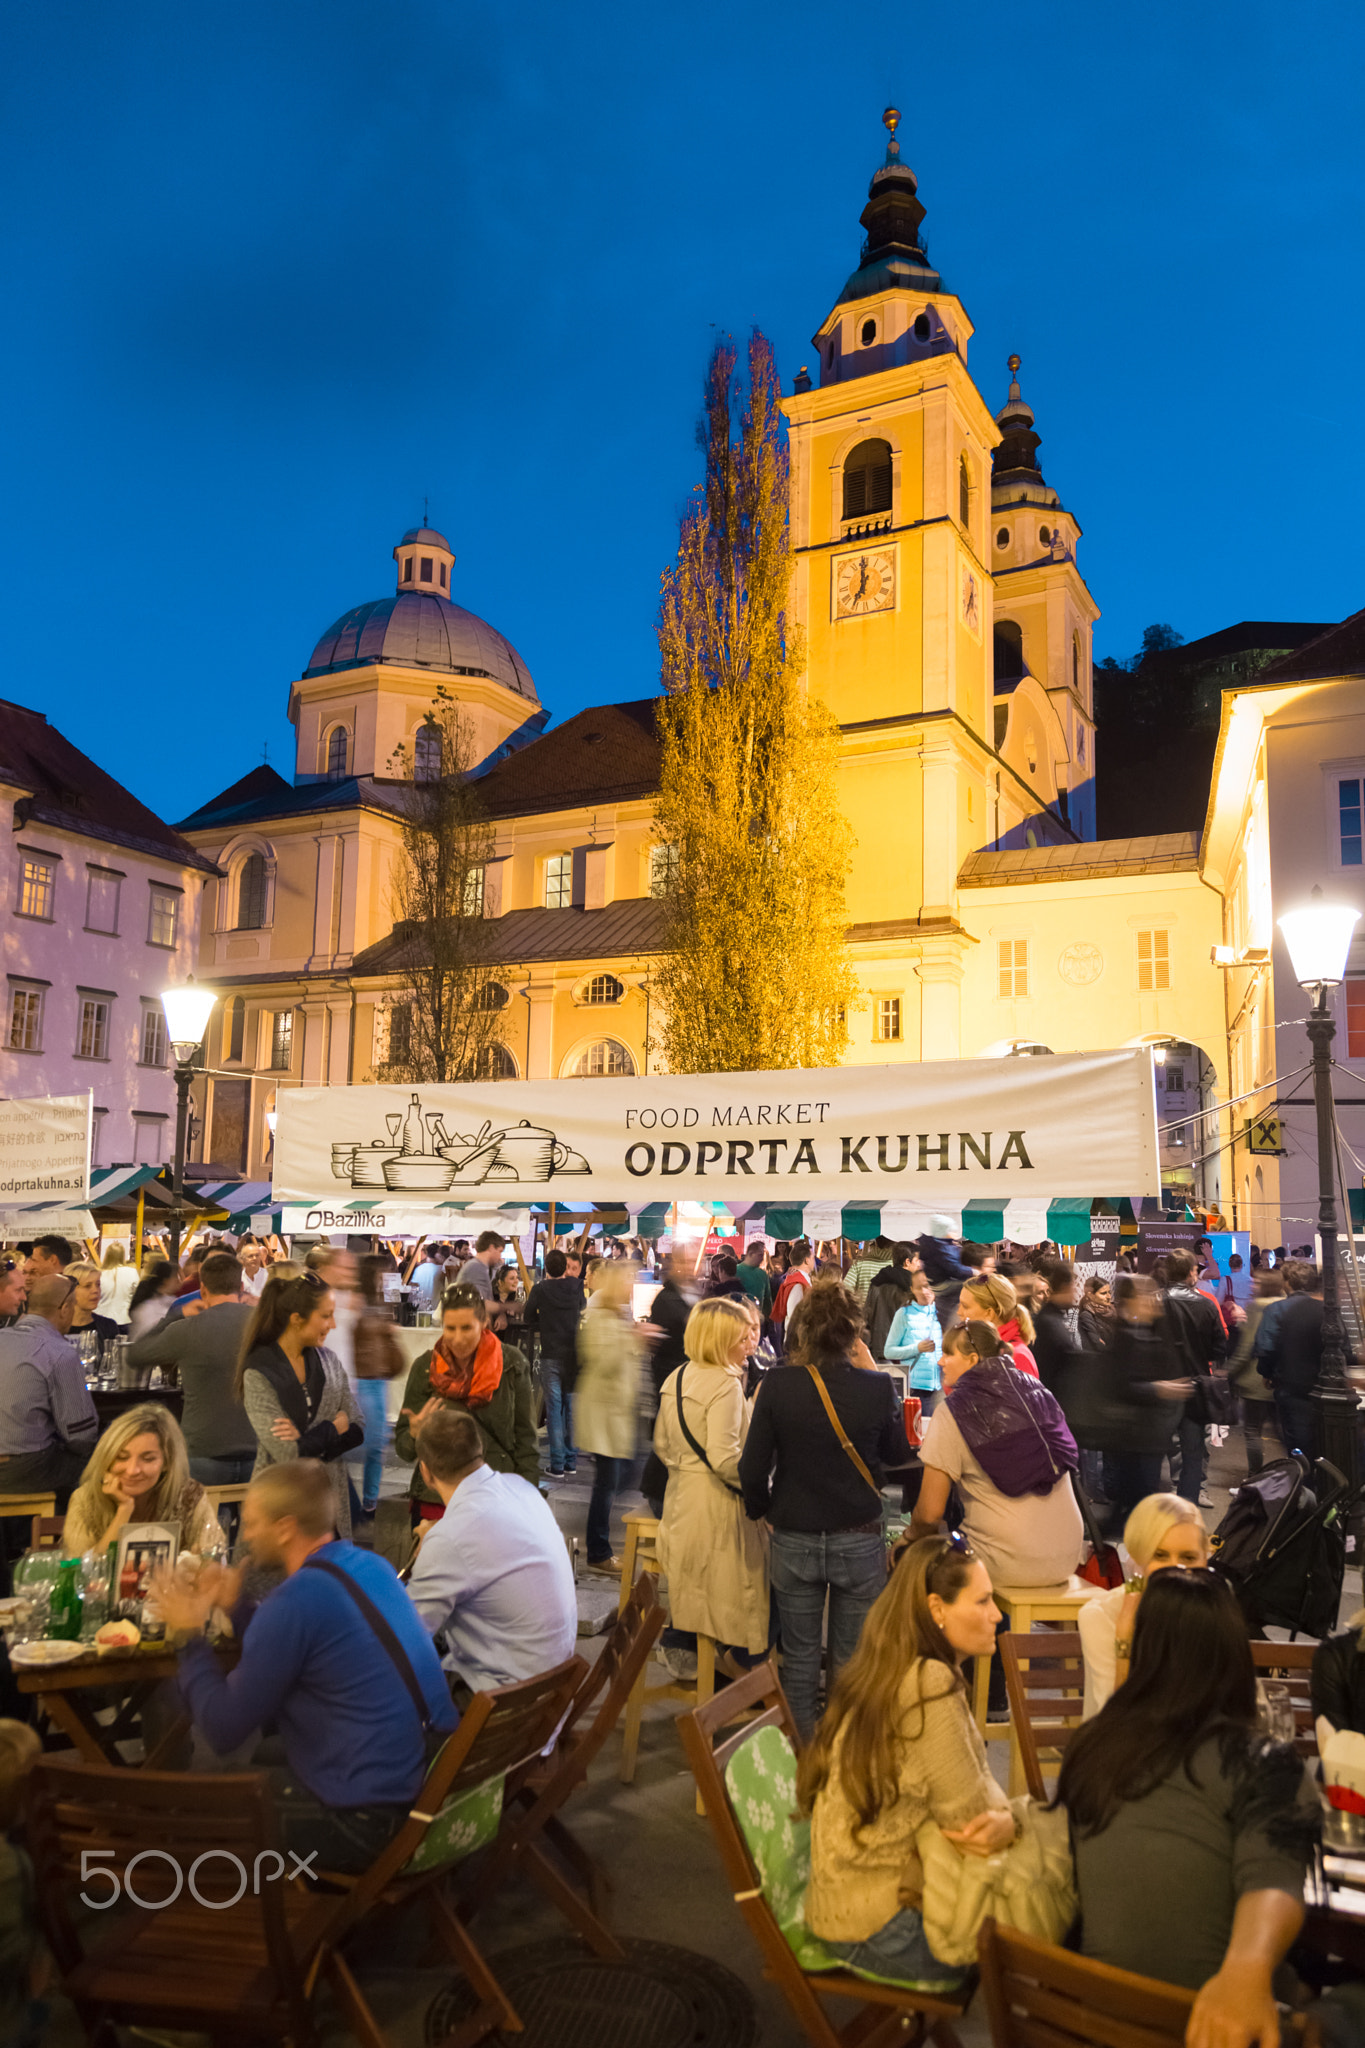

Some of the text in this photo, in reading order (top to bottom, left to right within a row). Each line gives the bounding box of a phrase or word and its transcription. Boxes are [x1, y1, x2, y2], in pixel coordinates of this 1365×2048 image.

[625, 1102, 831, 1129] FOOD MARKET
[624, 1130, 1036, 1177] ODPRTA KUHNA
[0, 1175, 83, 1194] odprtakuhna.si
